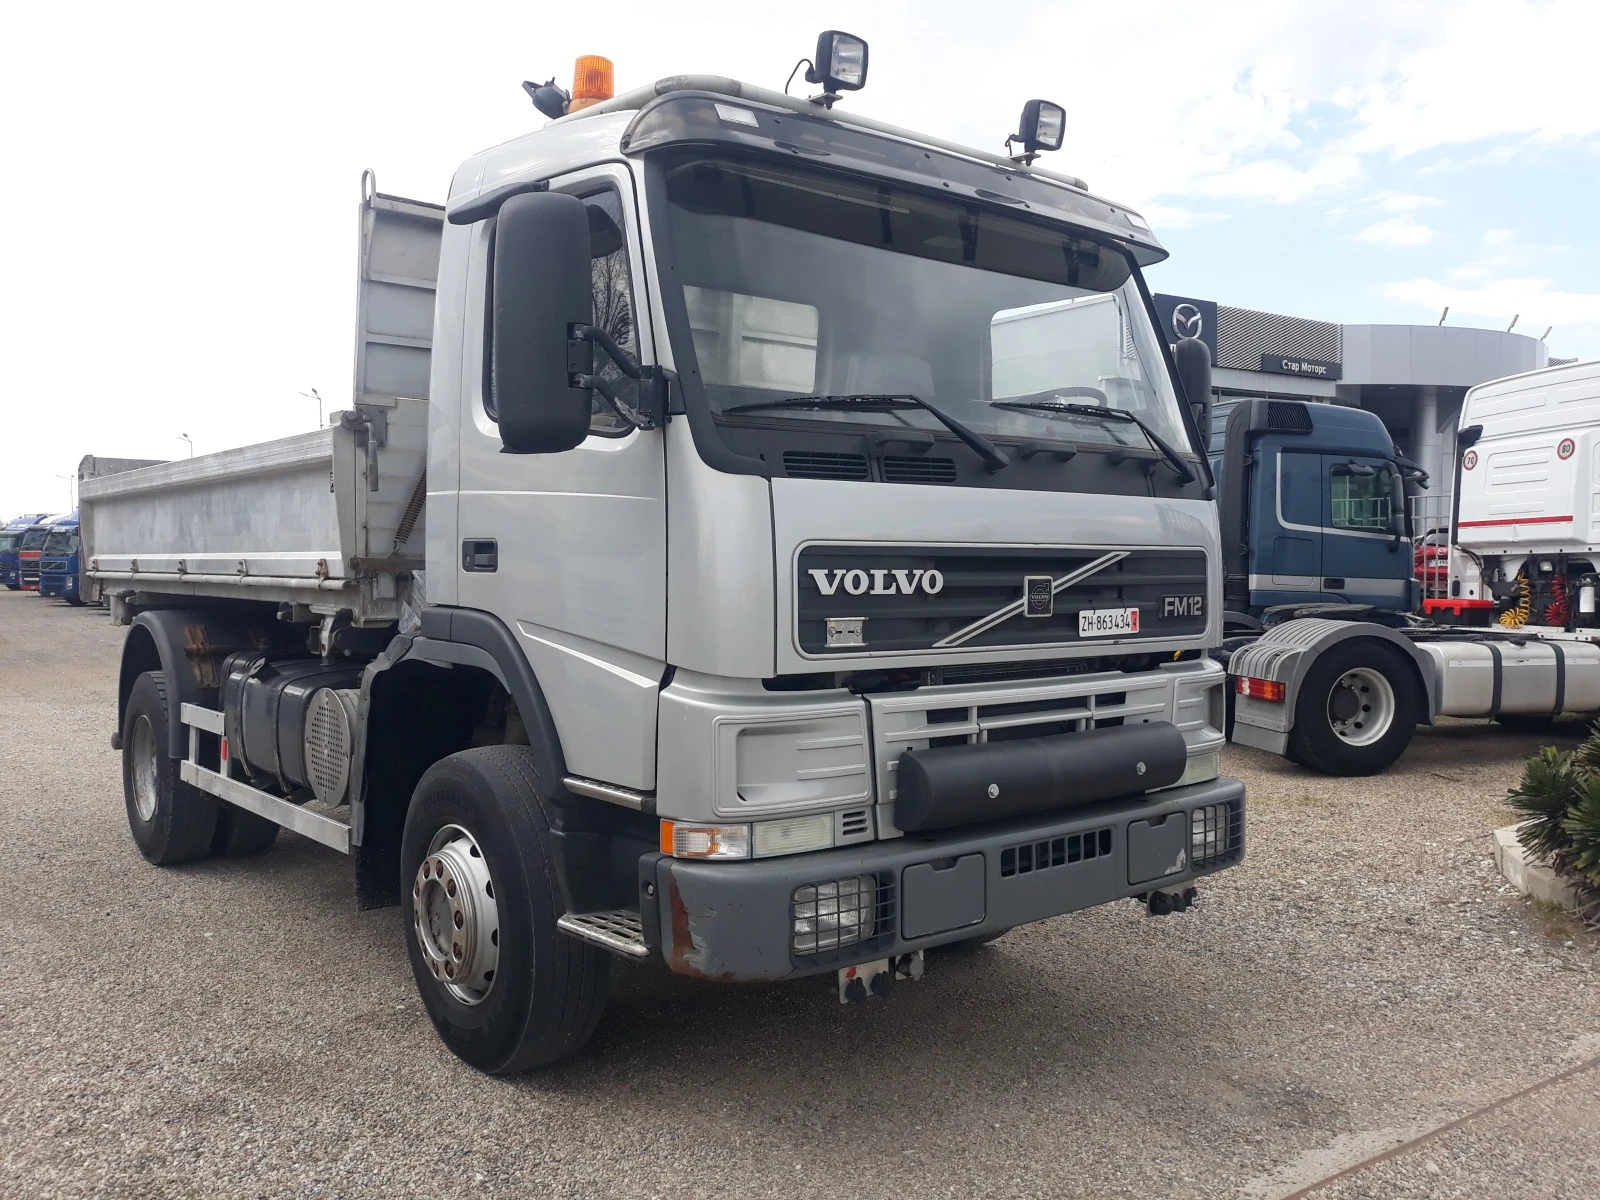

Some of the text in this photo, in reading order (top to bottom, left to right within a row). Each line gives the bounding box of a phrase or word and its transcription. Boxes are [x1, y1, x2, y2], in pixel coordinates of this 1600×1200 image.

[1282, 360, 1327, 375] Стар Моторс
[1561, 444, 1571, 454] 80
[1466, 456, 1475, 466] 70
[808, 569, 944, 595] VOLVO
[1164, 596, 1203, 617] FM12
